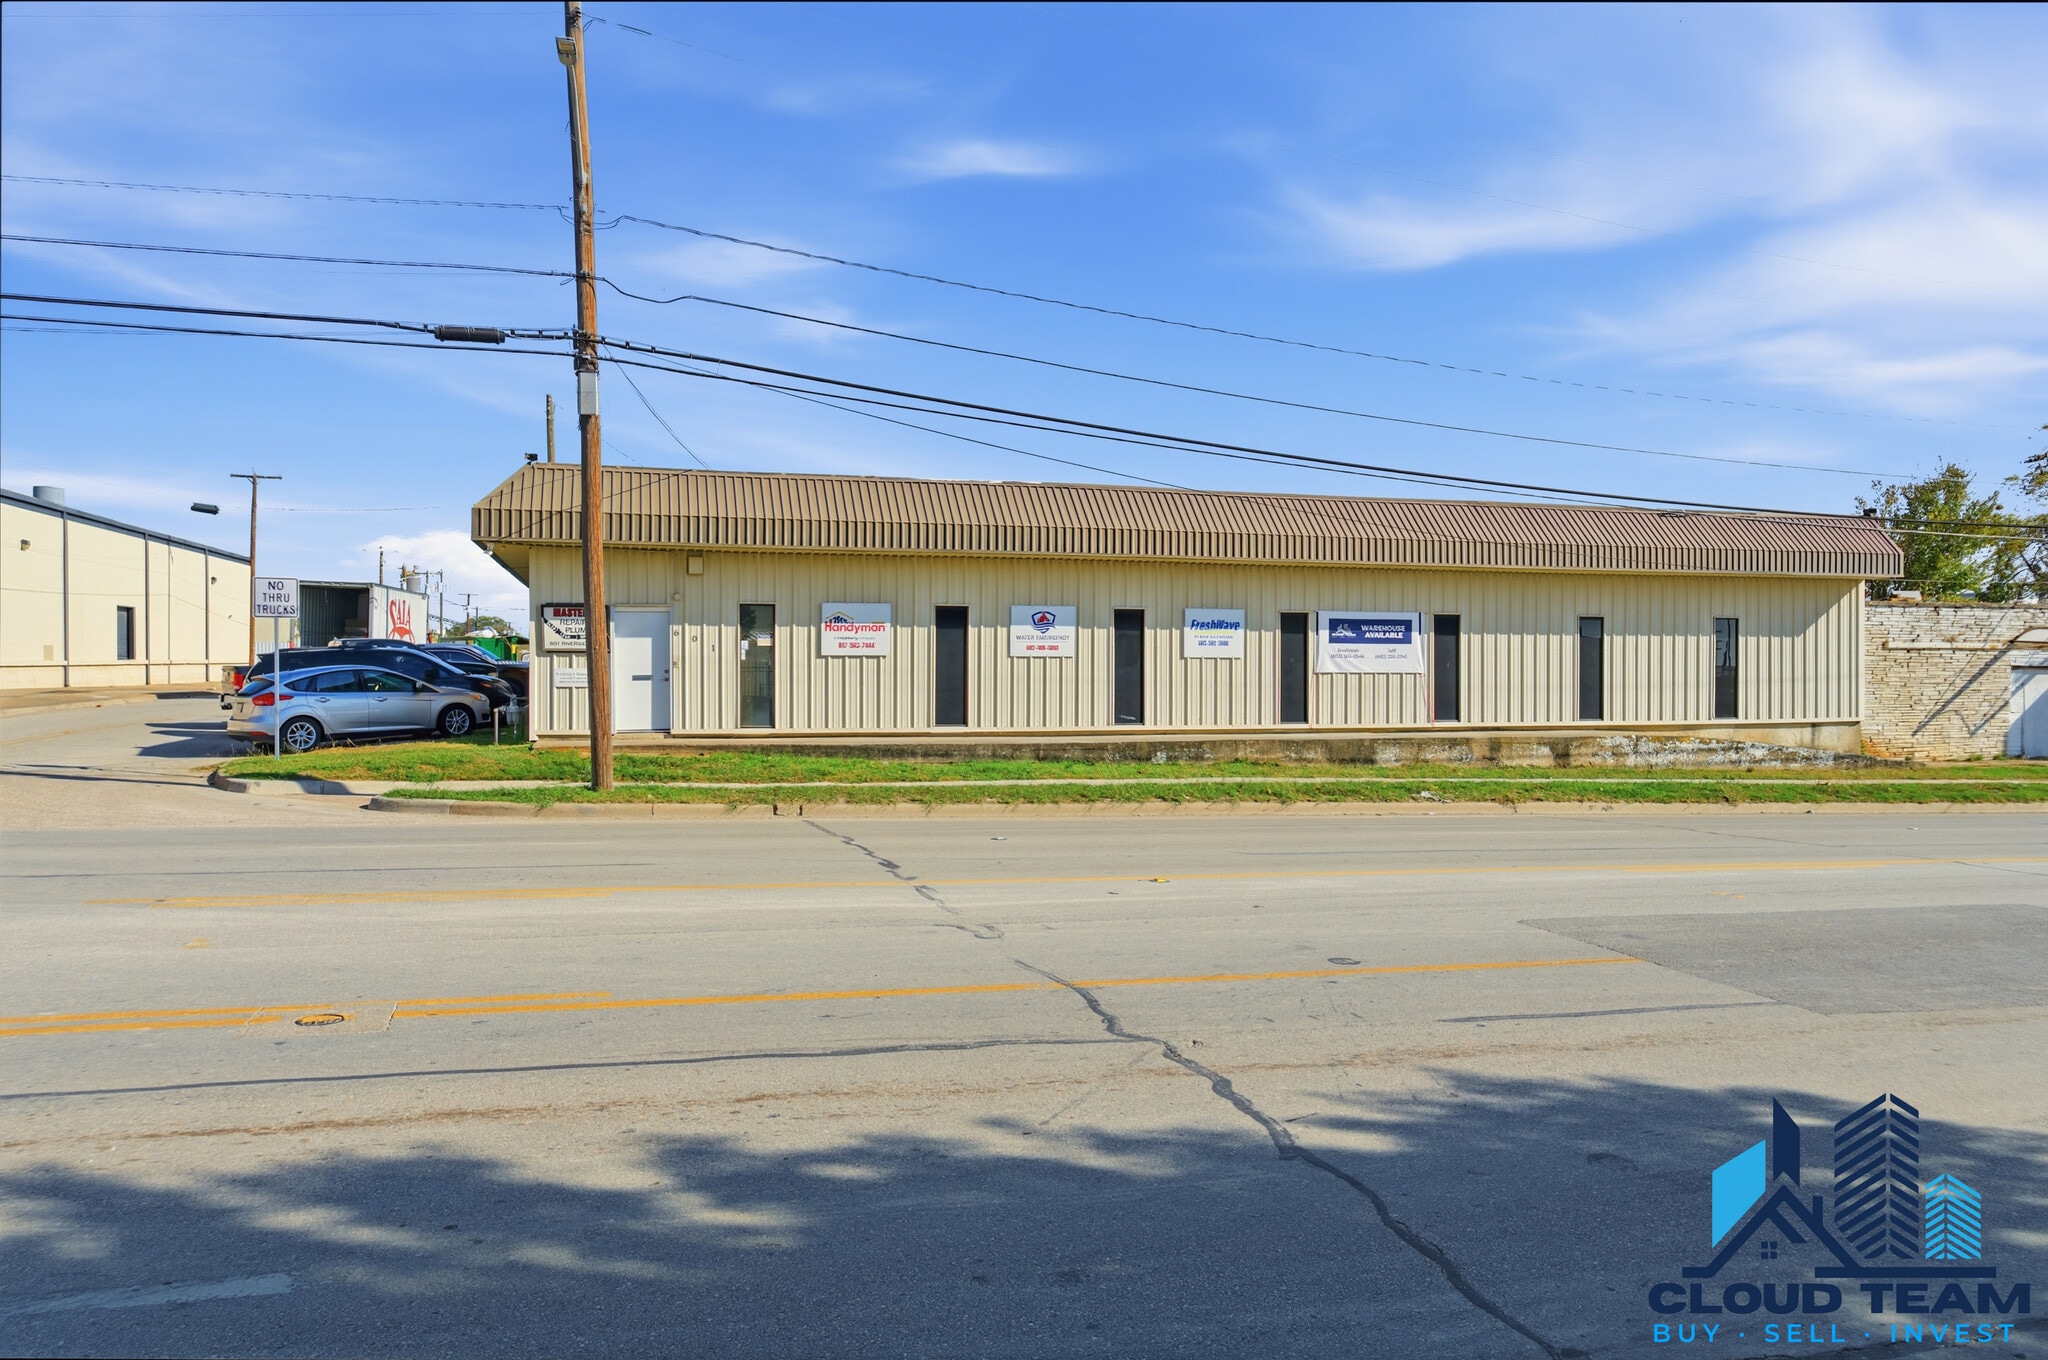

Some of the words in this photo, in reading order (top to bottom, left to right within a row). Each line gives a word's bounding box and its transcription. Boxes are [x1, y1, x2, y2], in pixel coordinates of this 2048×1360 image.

[268, 581, 284, 591] NO
[262, 592, 290, 603] THRU
[257, 604, 296, 615] TRUCKS
[553, 608, 585, 617] MASTE
[824, 620, 886, 634] Handyman
[1190, 619, 1241, 631] FreshWave
[1361, 624, 1406, 632] WAREHOUSE
[1364, 631, 1404, 639] AVAILABLE
